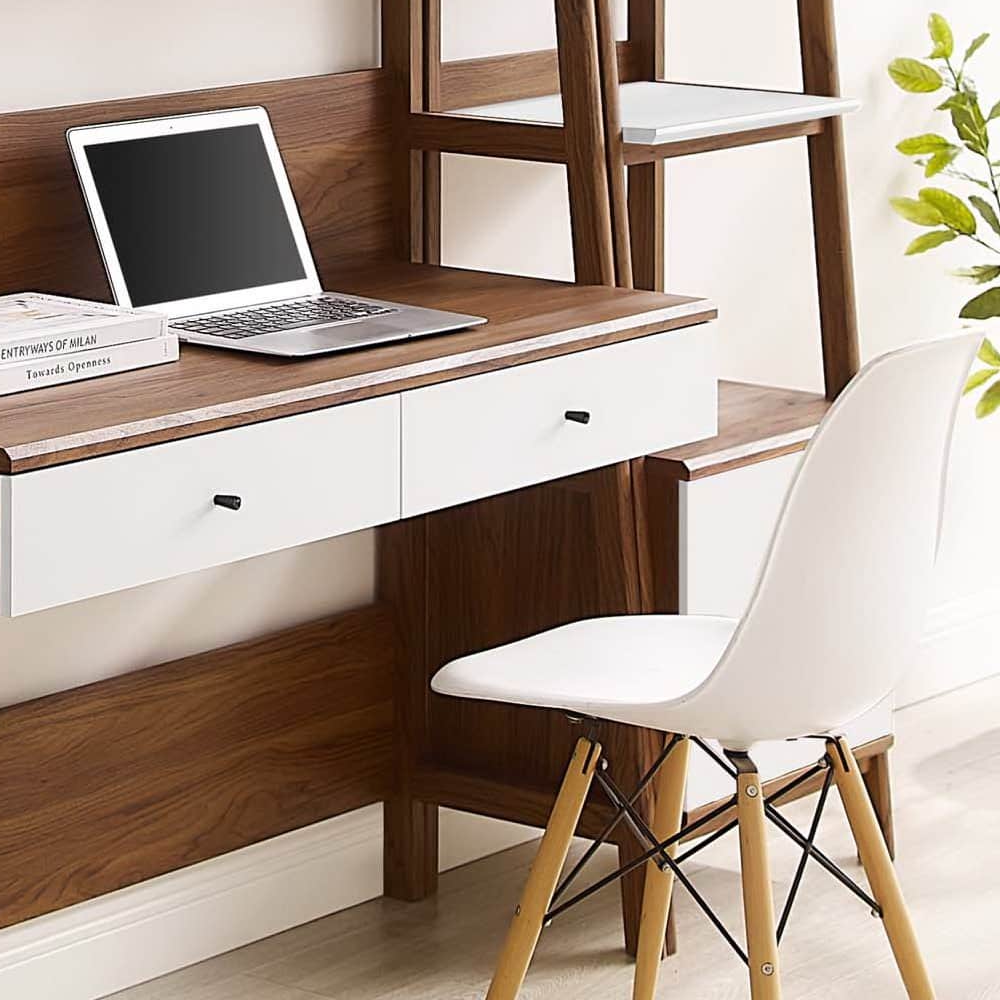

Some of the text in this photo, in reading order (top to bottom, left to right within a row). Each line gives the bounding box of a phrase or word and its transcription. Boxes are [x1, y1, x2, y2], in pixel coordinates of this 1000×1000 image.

[1, 334, 97, 360] ENTRYWAYS OF MILAN
[26, 357, 112, 380] Towards Openness
